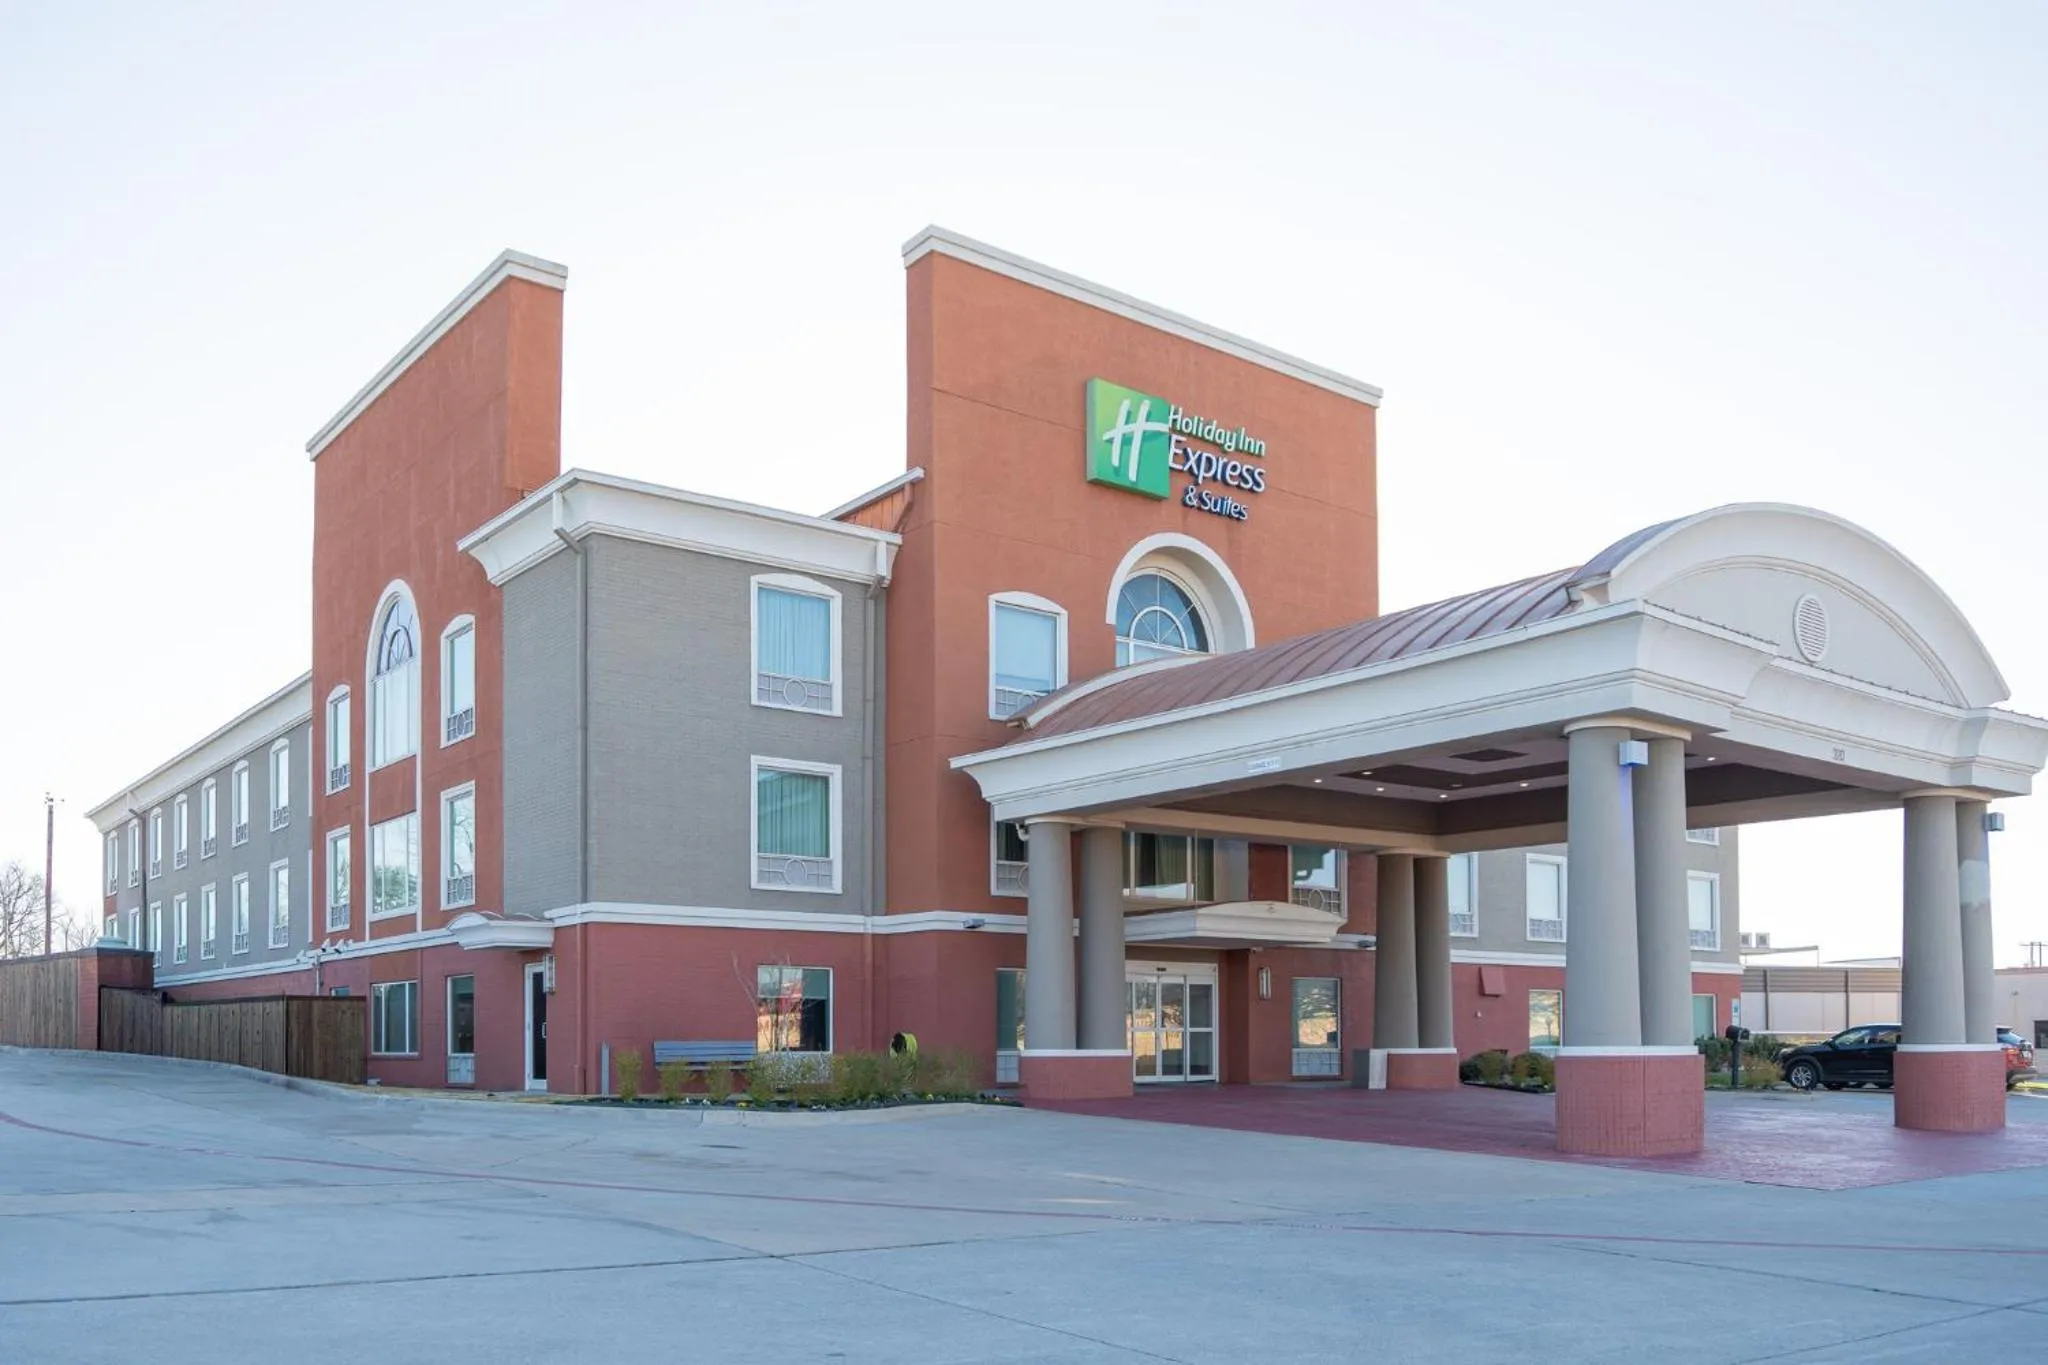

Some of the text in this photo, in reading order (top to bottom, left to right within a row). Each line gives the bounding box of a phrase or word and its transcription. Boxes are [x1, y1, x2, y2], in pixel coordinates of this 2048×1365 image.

[1168, 404, 1266, 457] Holiday Inn
[1168, 433, 1266, 493] Express
[1184, 485, 1249, 520] & Suites
